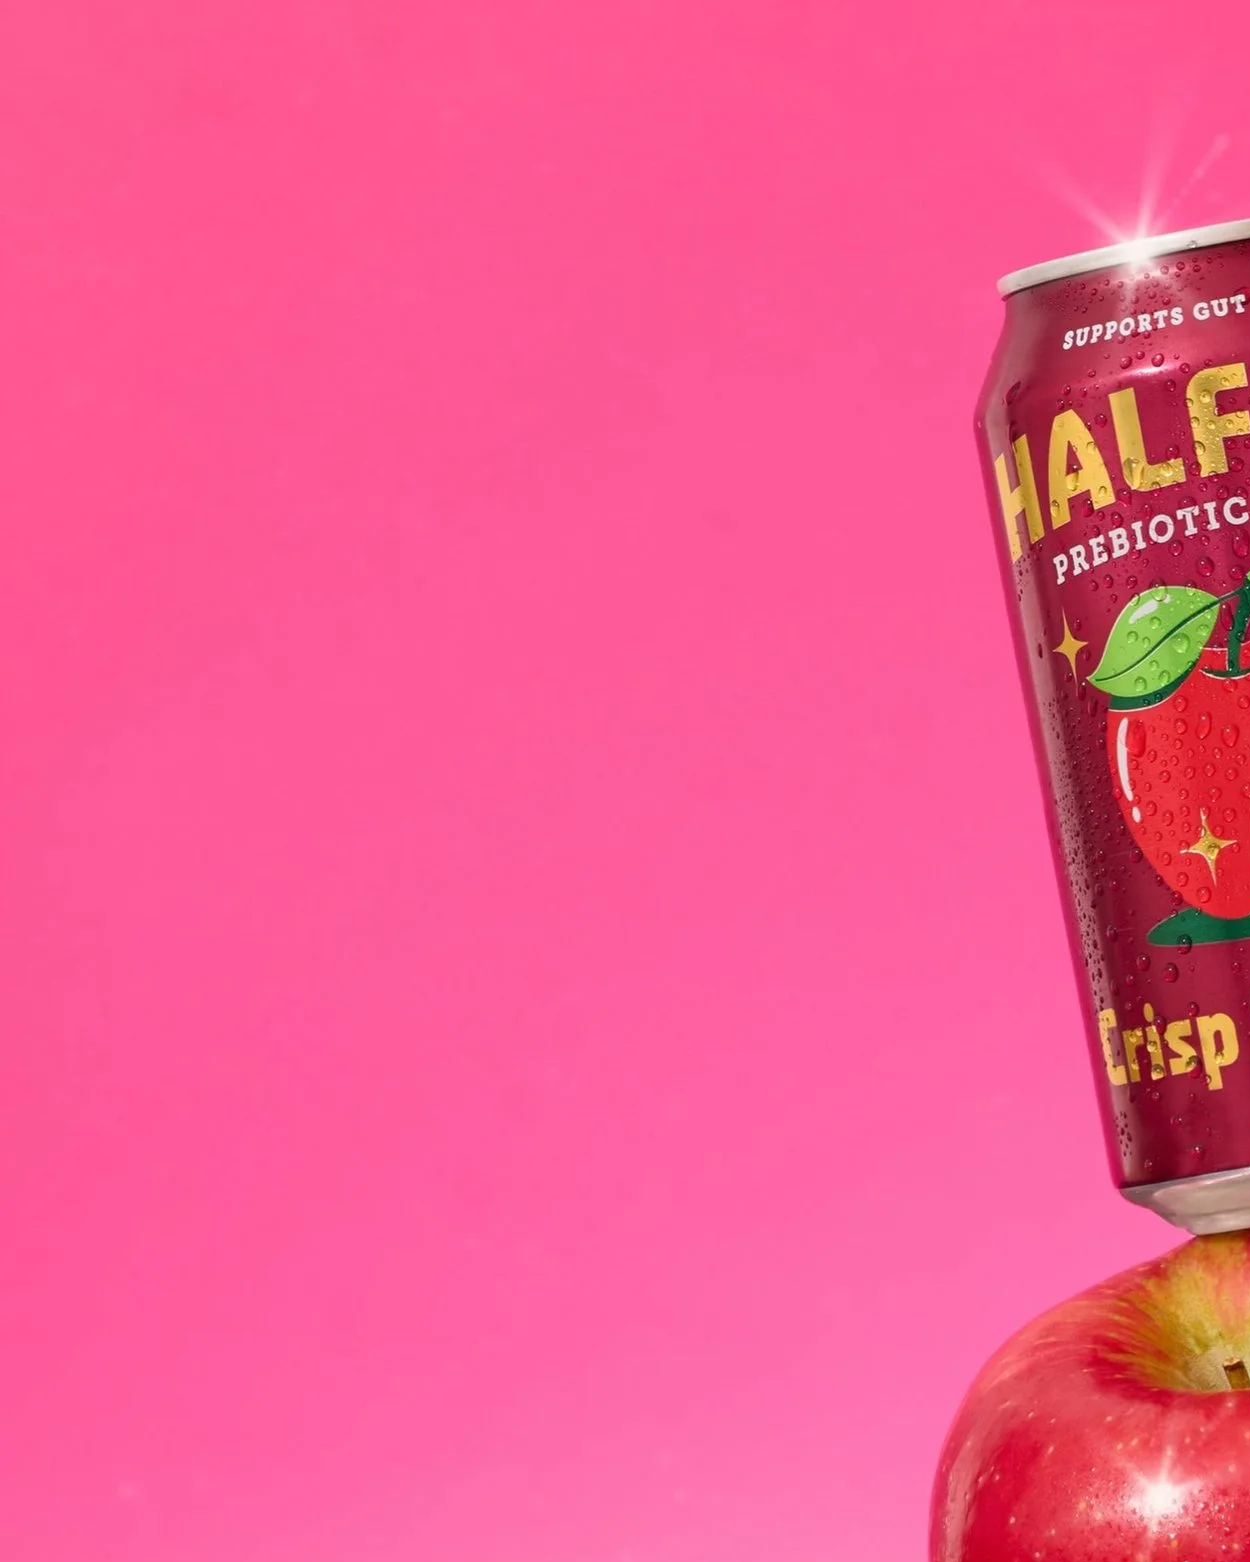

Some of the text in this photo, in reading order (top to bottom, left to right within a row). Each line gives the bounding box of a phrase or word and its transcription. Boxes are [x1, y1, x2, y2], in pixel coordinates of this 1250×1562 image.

[1062, 307, 1184, 350] SUPPORTS
[1193, 294, 1246, 321] GUT
[1052, 496, 1249, 585] PREBIOTIC
[1099, 1003, 1239, 1091] Crisp
